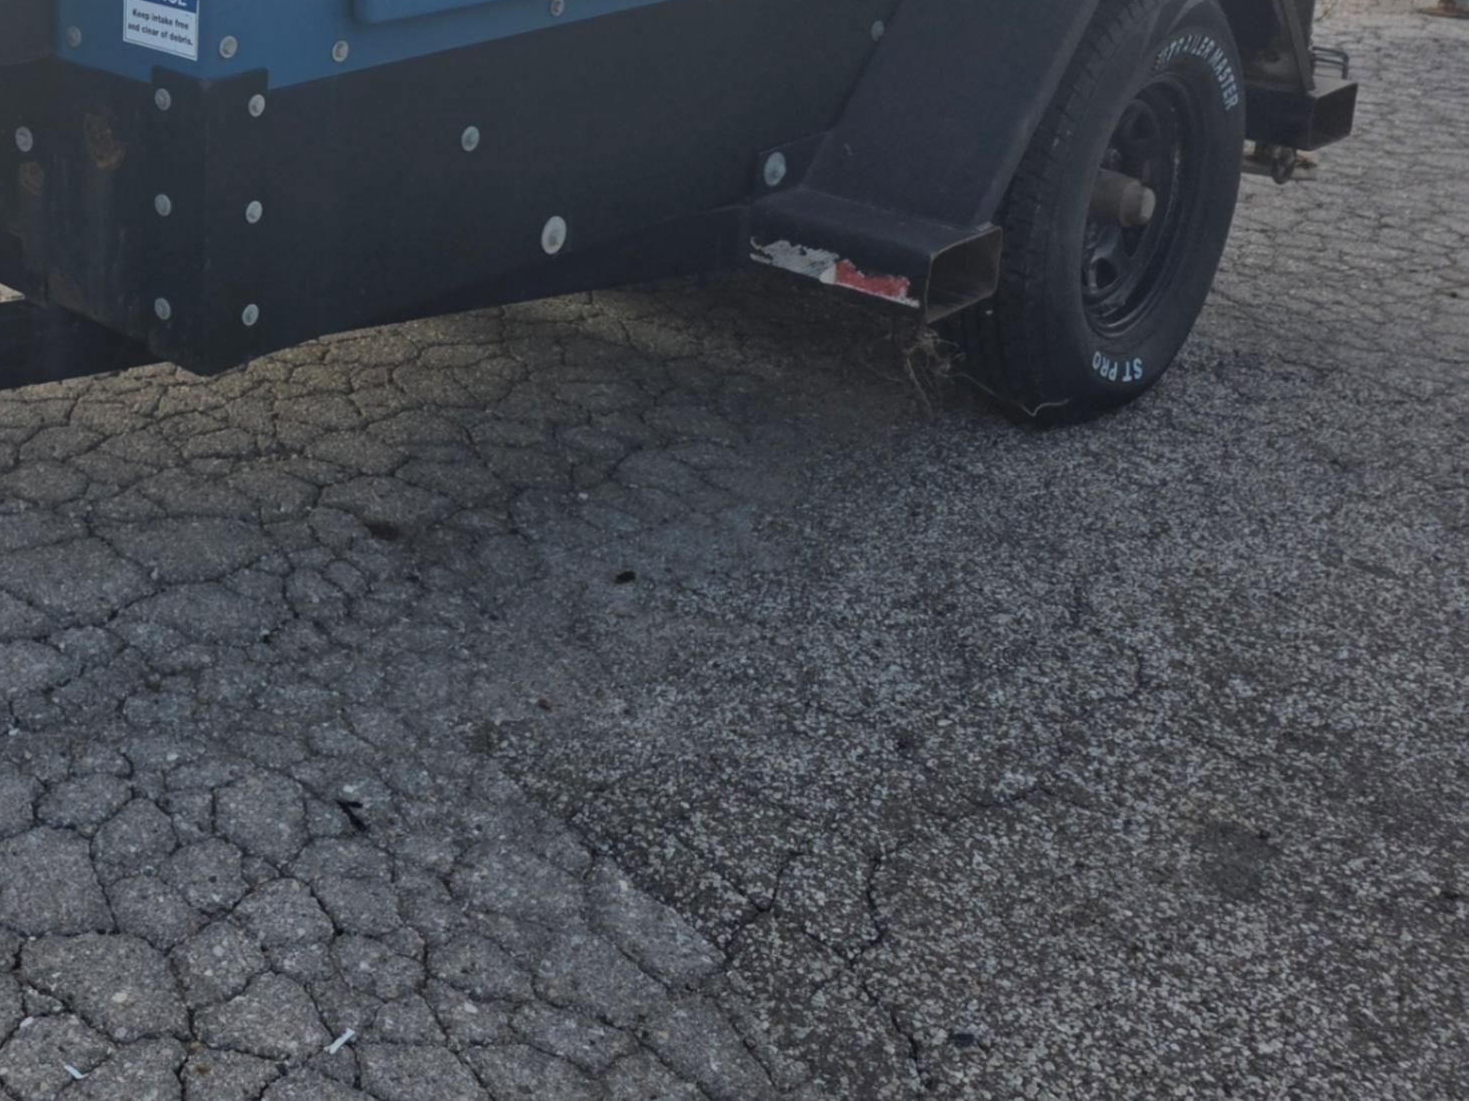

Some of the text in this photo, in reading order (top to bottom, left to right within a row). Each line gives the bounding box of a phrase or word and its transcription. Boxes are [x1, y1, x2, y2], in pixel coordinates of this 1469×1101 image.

[128, 23, 140, 32] and
[141, 26, 159, 36] clear
[132, 8, 189, 30] Keep intake free
[1209, 47, 1239, 111] MASTER
[1092, 351, 1143, 382] ST PRO
